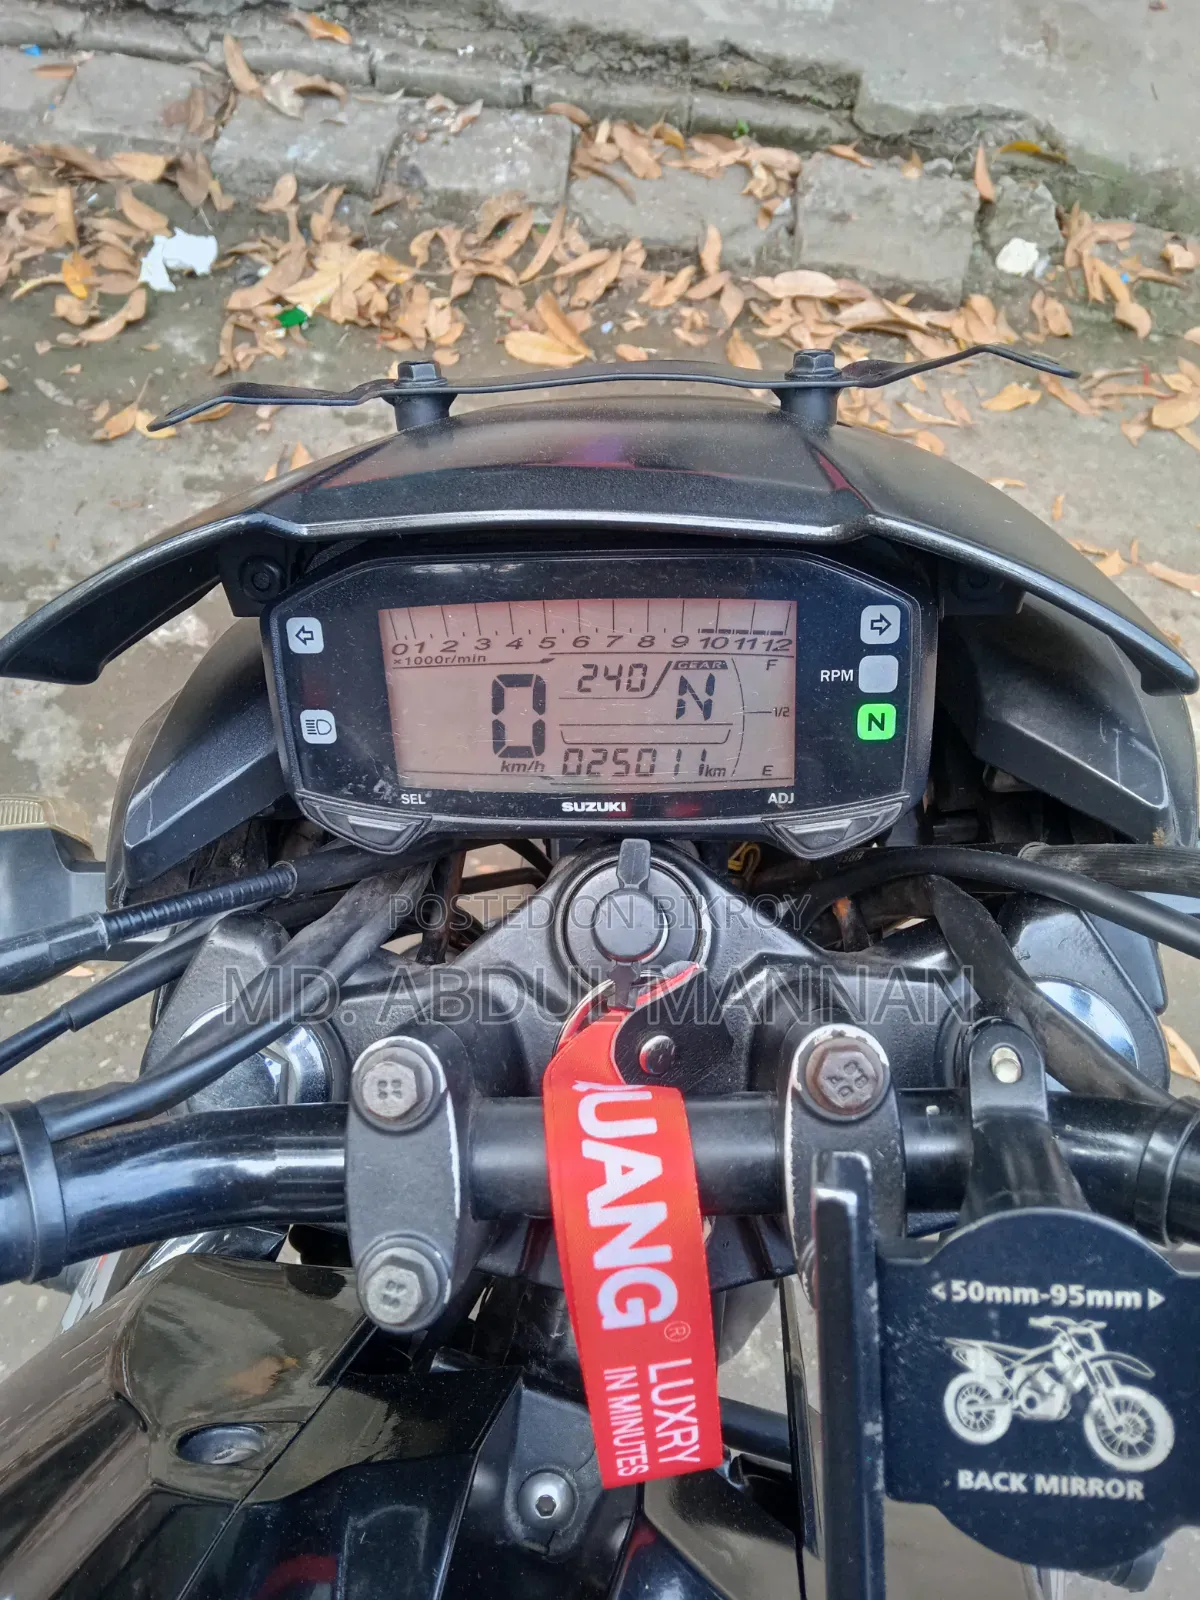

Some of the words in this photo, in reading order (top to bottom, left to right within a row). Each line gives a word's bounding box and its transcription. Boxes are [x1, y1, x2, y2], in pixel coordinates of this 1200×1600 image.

[391, 643, 408, 655] 0
[414, 642, 426, 654] 1
[440, 640, 459, 653] 2
[474, 638, 491, 650] 3
[505, 637, 523, 650] 4
[538, 636, 557, 649] 5
[572, 635, 591, 648] 6
[606, 635, 624, 648] 7
[637, 635, 656, 648] 8
[671, 635, 689, 648] 9
[699, 636, 730, 649] 10
[734, 637, 758, 650] 11
[762, 638, 793, 652] 12
[677, 660, 724, 670] GEAR
[766, 659, 778, 671] F
[577, 663, 648, 693] 240
[820, 669, 854, 682] RPM
[675, 673, 716, 721] N
[491, 673, 547, 759] 0
[773, 707, 790, 718] 1/2
[867, 712, 886, 732] N
[500, 759, 546, 774] km/h
[561, 748, 707, 777] 025011
[704, 766, 727, 777] km
[762, 765, 774, 776] E
[401, 793, 427, 806] SEL
[561, 801, 627, 813] SUZUKI
[768, 792, 795, 804] ADJ
[950, 1279, 1143, 1309] 50mm-95mm
[604, 1366, 637, 1391] IN
[648, 1357, 701, 1464] LUXRY
[607, 1393, 649, 1478] MINUTES
[957, 1469, 1028, 1493] BACK
[1034, 1473, 1146, 1500] MIRROR
